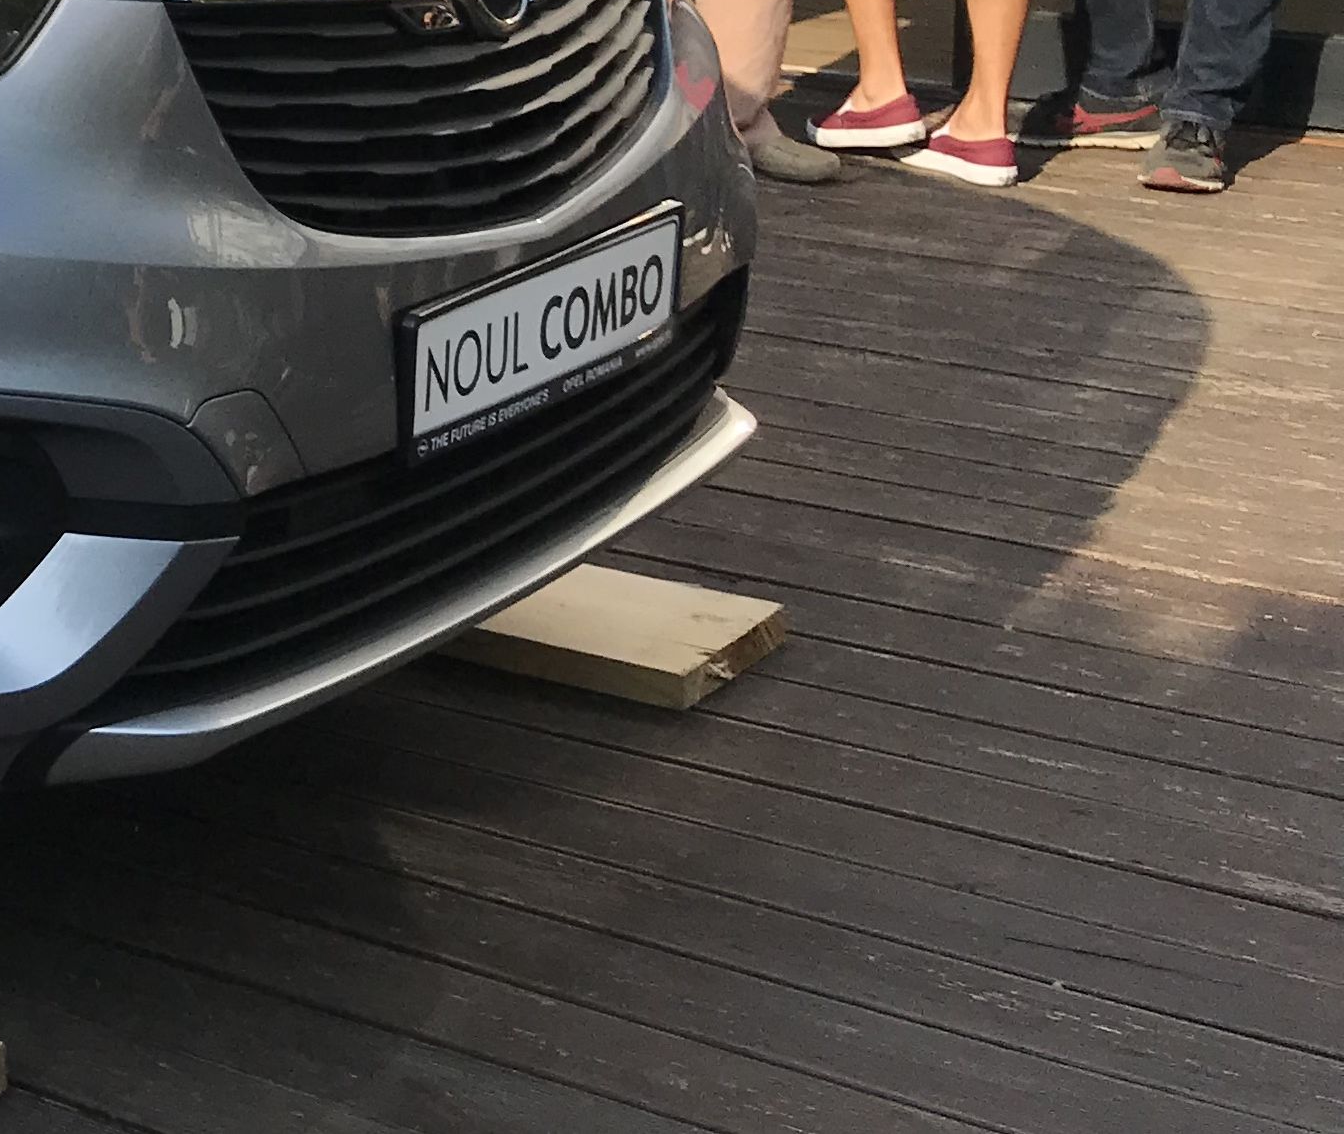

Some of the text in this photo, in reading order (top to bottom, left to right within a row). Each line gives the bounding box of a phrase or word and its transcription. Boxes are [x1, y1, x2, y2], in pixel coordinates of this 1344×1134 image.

[424, 254, 663, 412] NOUL COMBO
[431, 432, 449, 450] THE
[450, 416, 487, 443] FUTURE
[487, 412, 497, 427] IS
